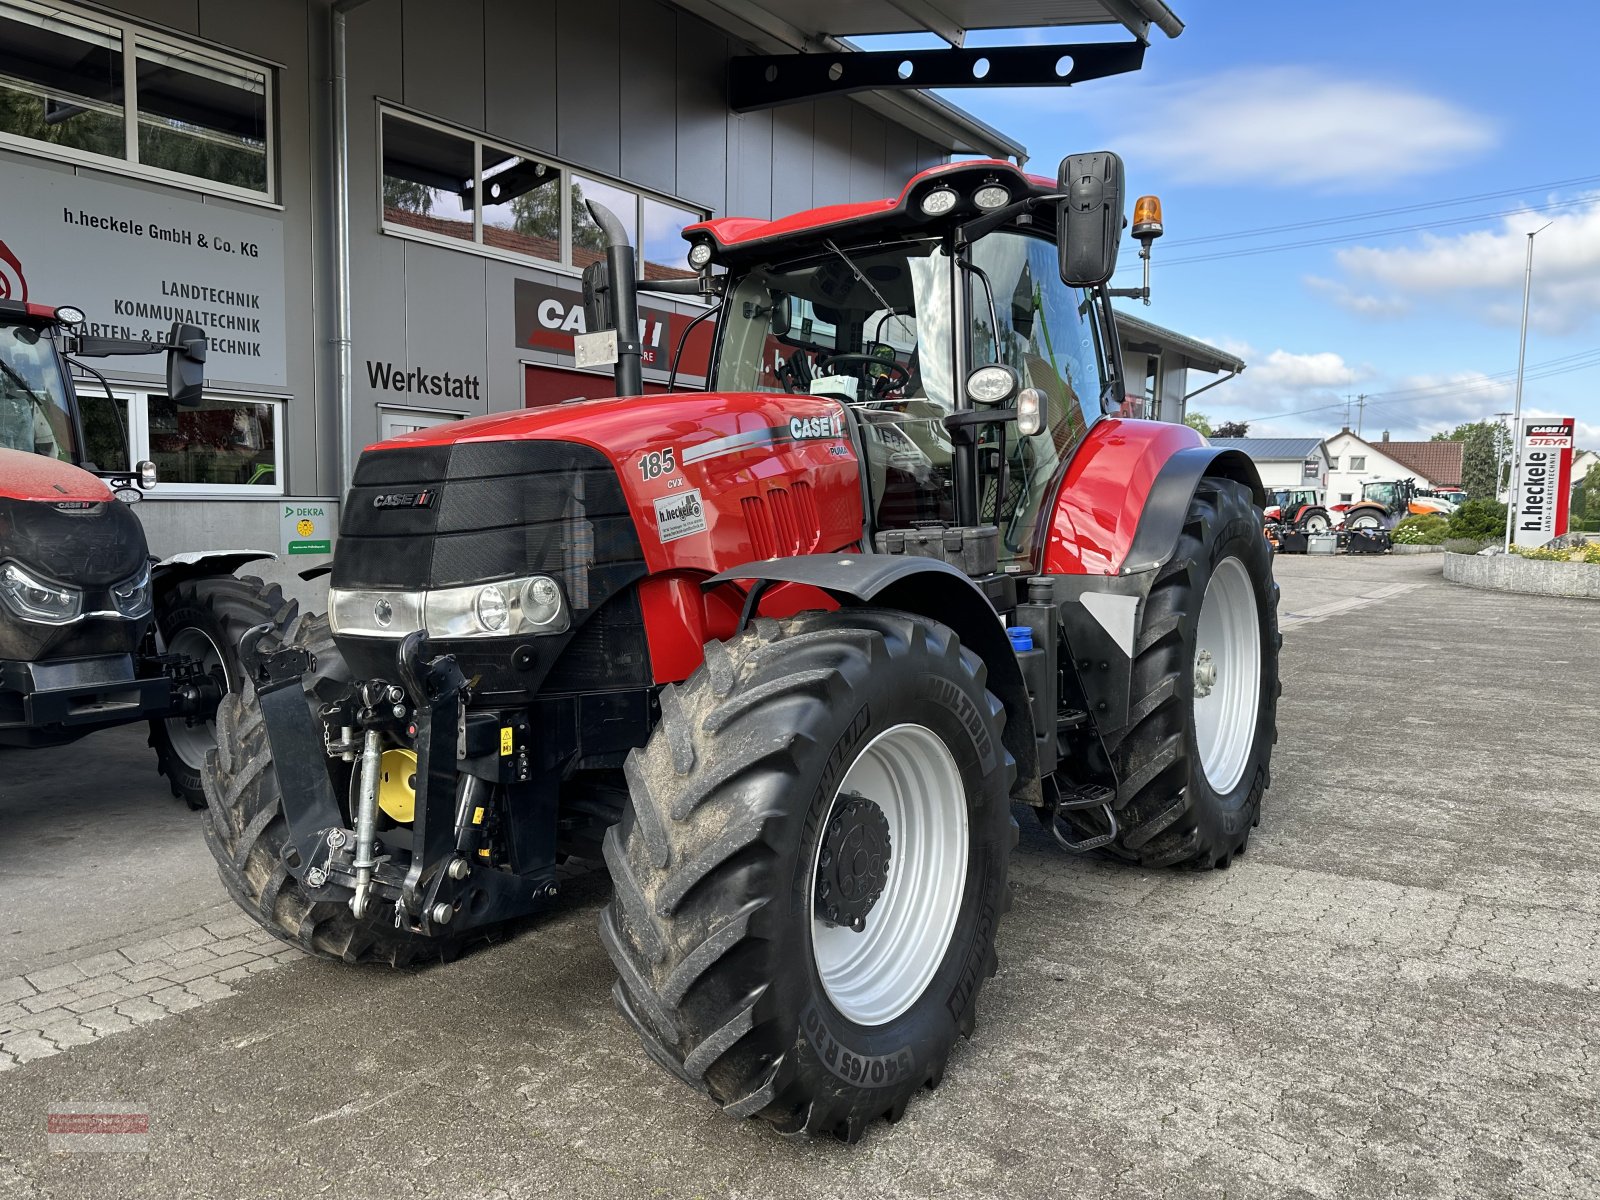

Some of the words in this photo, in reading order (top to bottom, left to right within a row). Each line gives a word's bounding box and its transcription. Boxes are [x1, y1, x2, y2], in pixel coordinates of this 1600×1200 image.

[63, 207, 143, 236] h.heckele
[149, 224, 192, 245] GmbH
[197, 233, 208, 249] &
[213, 236, 235, 254] Co.
[240, 241, 258, 257] KG
[161, 280, 260, 309] LANDTECHNIK
[114, 299, 260, 333] KOMMUNALTECHNIK
[141, 329, 152, 342] &
[366, 360, 480, 400] Werkstatt
[790, 416, 830, 439] CASE
[1528, 438, 1568, 446] STEYR
[637, 446, 676, 482] 185
[830, 447, 849, 456] PUMA
[667, 477, 683, 489] CVX
[1520, 452, 1547, 531] h.heckele
[1547, 452, 1557, 505] GARTENTECHNIK
[296, 508, 324, 516] DEKRA
[373, 493, 415, 508] CASE
[1544, 512, 1552, 532] LAND-
[928, 677, 991, 759] MULTIBIB
[824, 1038, 839, 1067] R
[839, 1051, 911, 1084] 540/65
